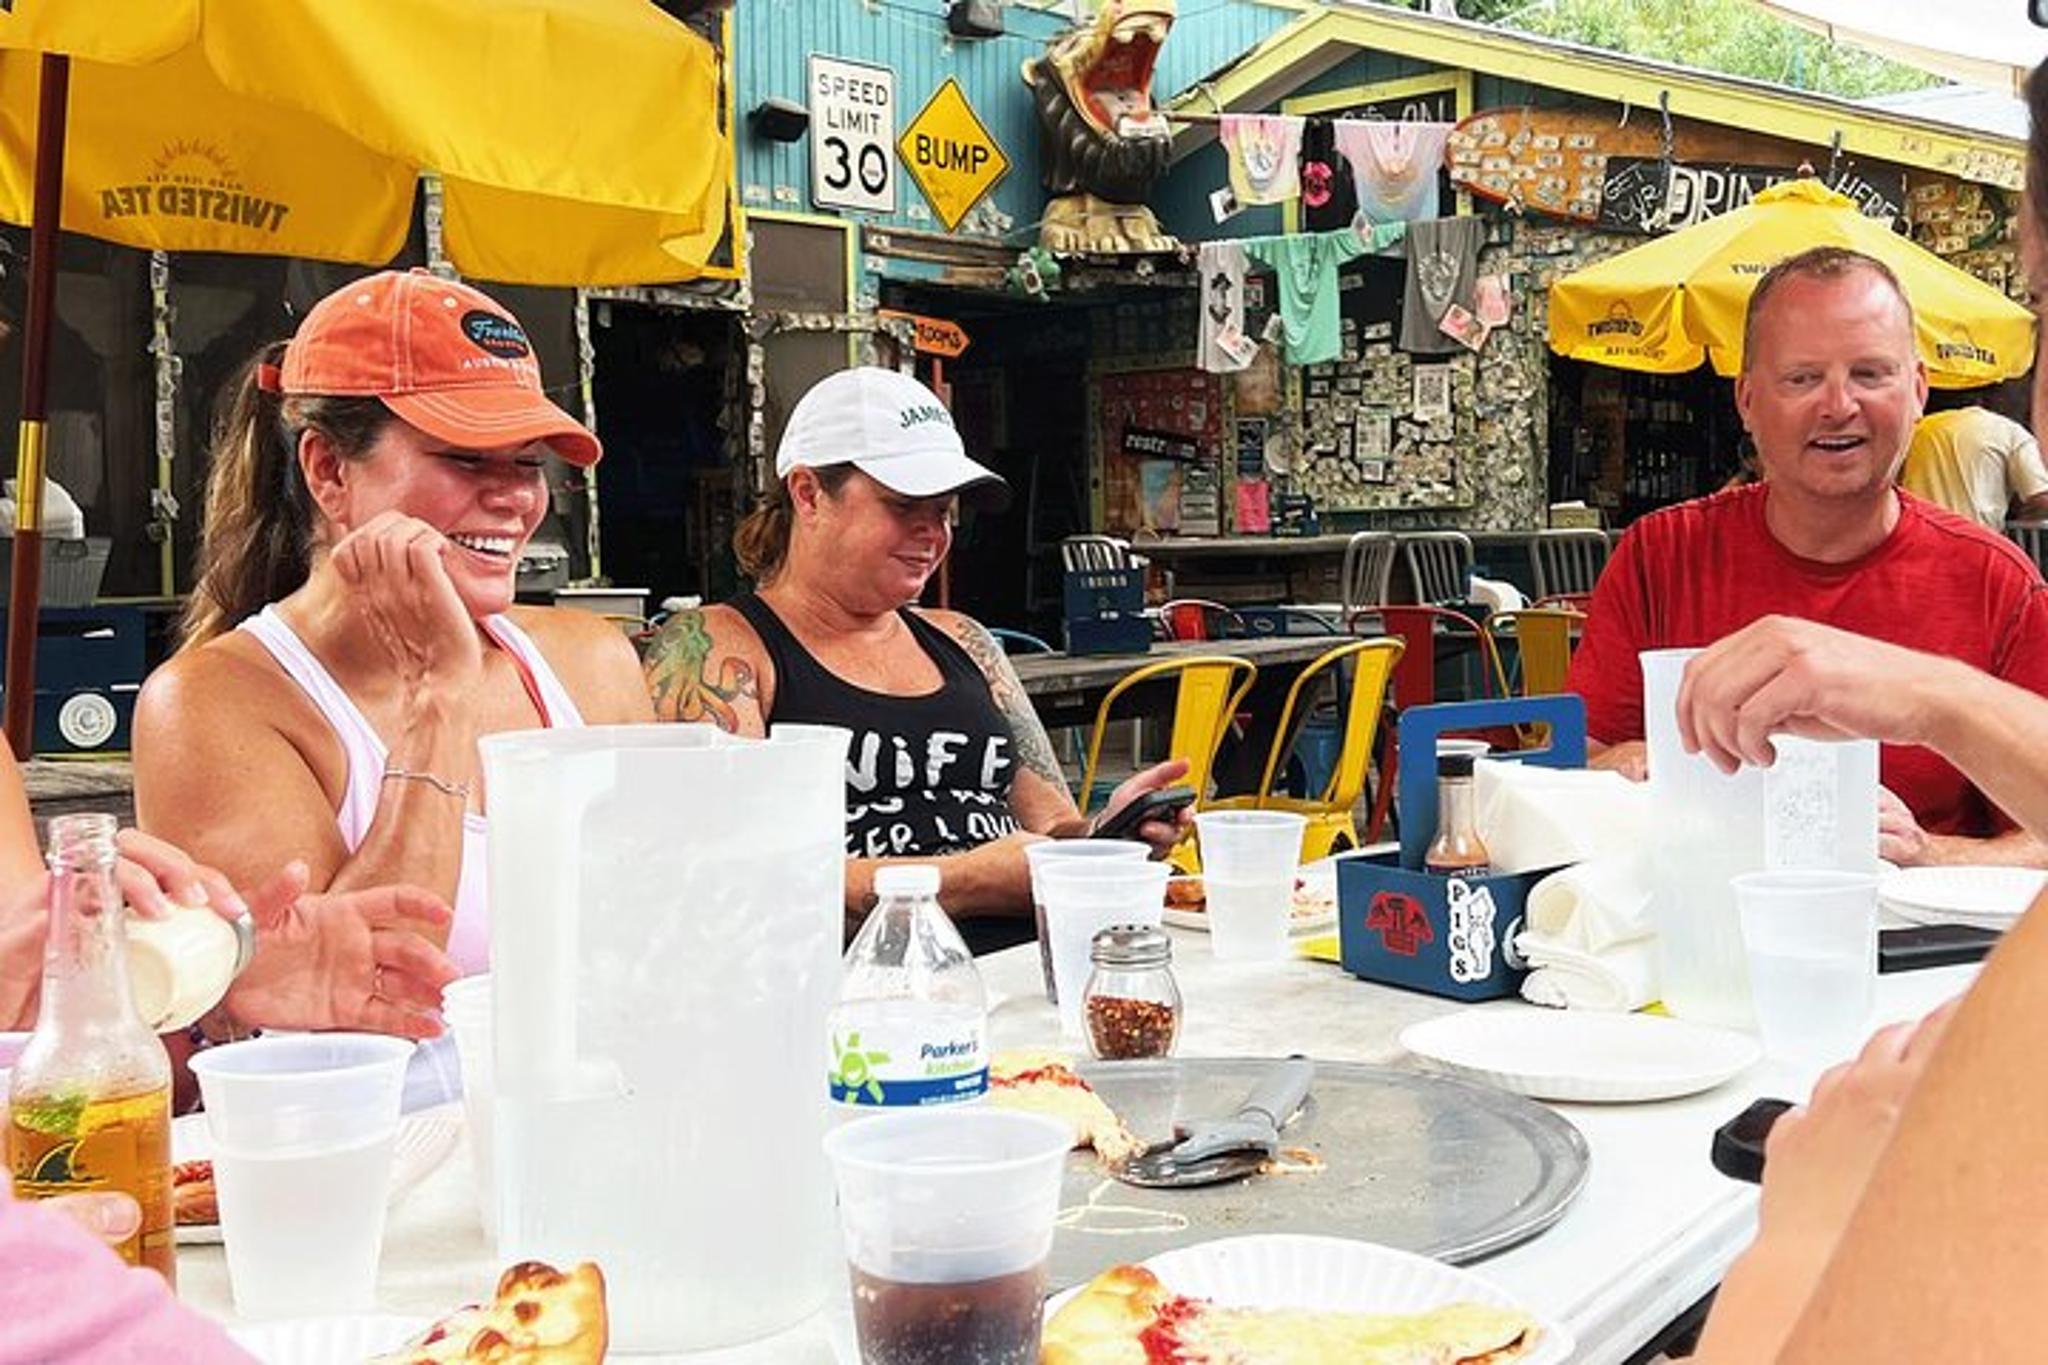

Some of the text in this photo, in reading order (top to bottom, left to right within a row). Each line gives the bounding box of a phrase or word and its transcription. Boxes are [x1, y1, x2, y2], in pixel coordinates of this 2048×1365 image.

[818, 73, 889, 107] SPEED
[827, 105, 881, 135] LIMIT
[823, 136, 889, 196] 30
[915, 132, 990, 175] BUMP
[1452, 884, 1467, 976] PIGS
